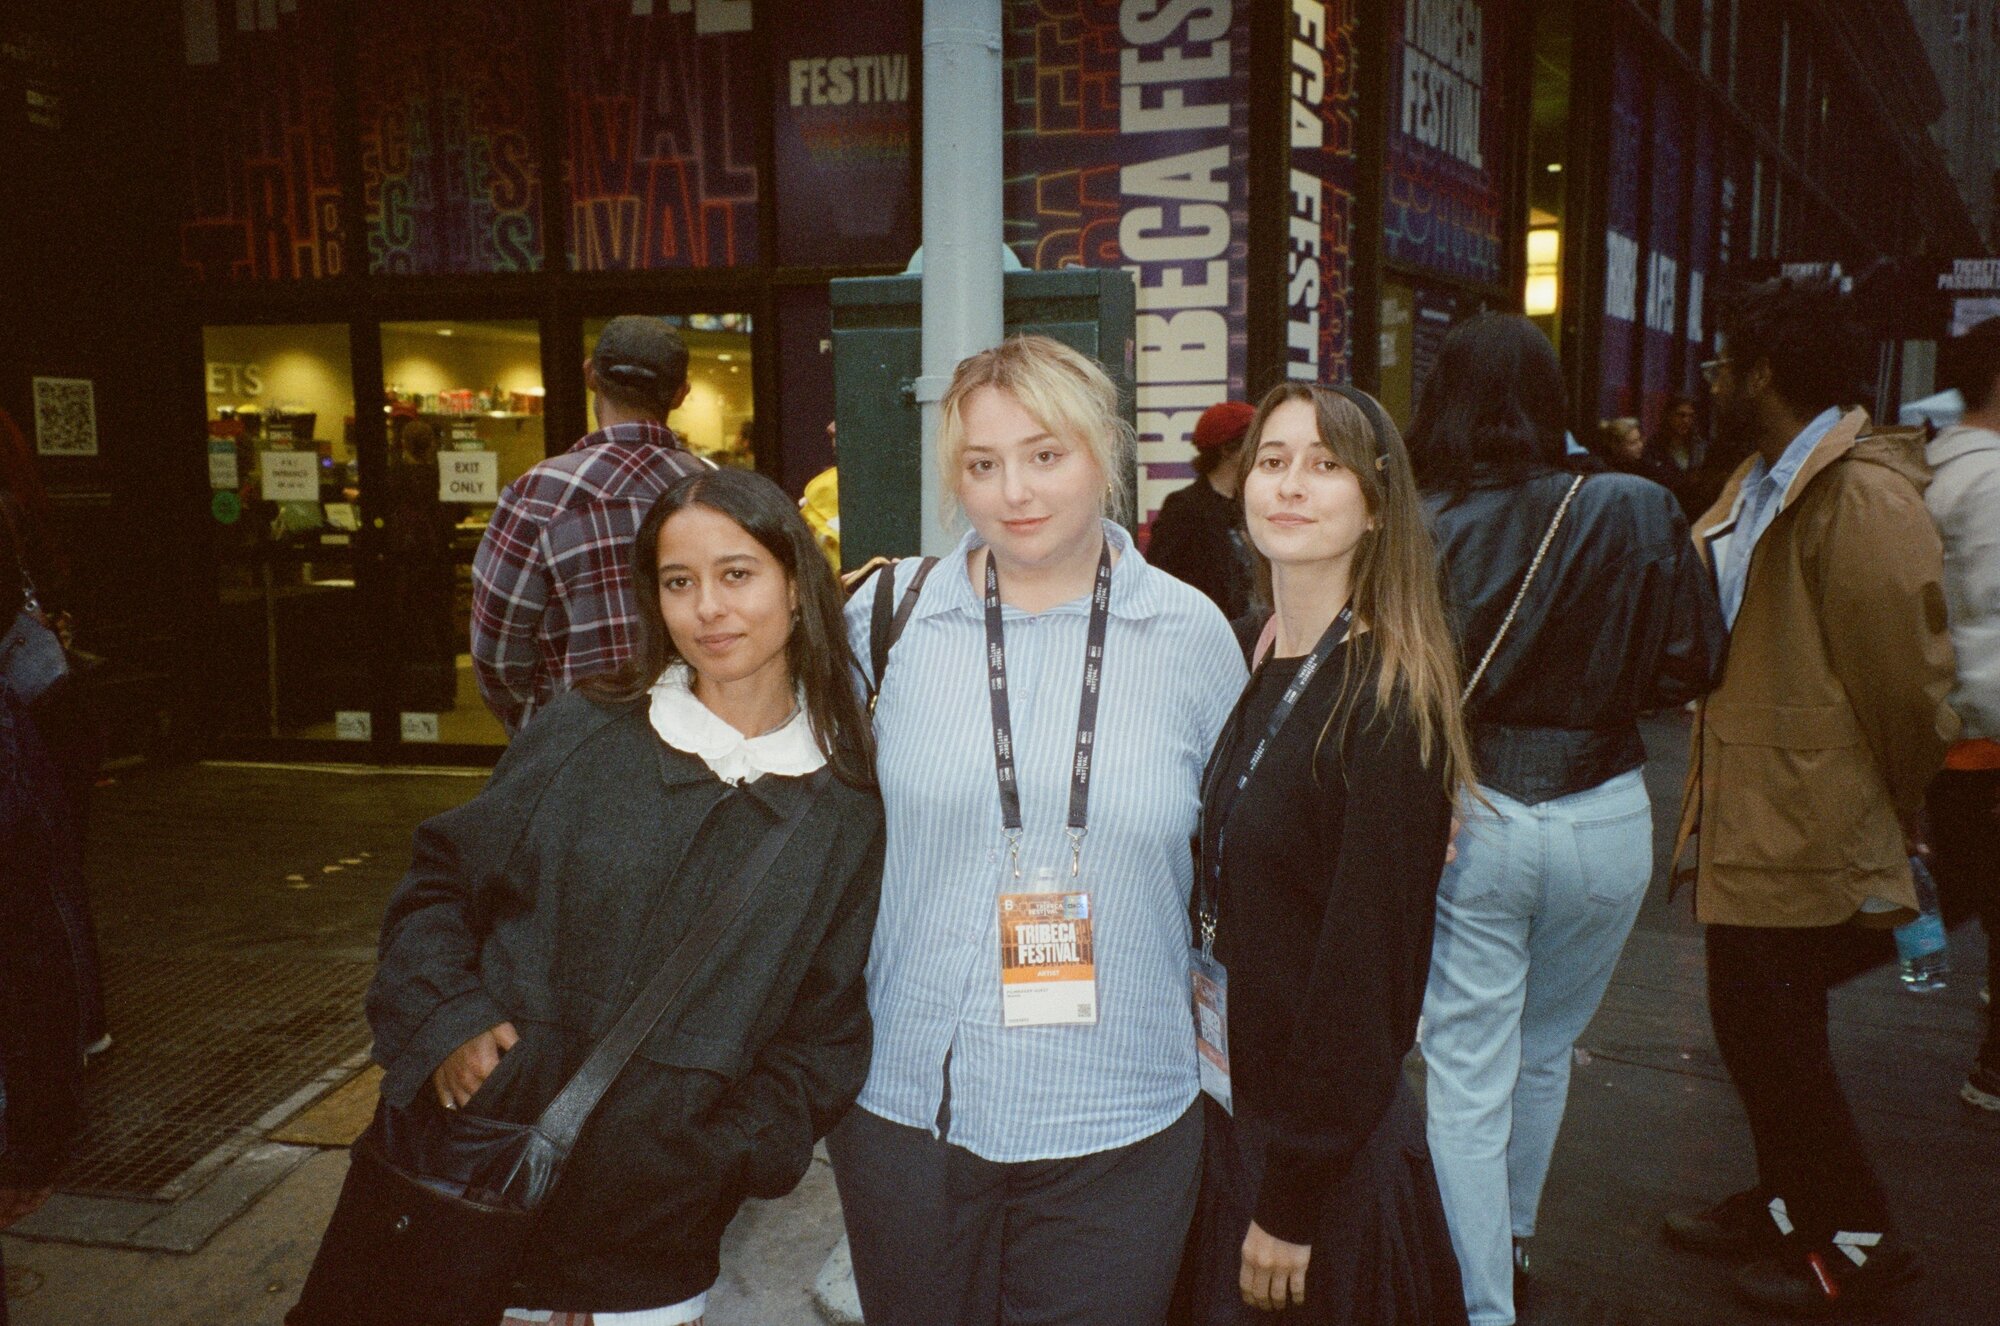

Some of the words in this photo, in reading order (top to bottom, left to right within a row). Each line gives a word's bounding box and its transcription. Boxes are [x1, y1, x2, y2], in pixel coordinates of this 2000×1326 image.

[1287, 168, 1322, 380] FESTI
[455, 461, 480, 474] EXIT
[450, 481, 484, 493] ONLY
[1014, 922, 1077, 946] TRIBECA
[1018, 941, 1080, 965] FESTIVAL
